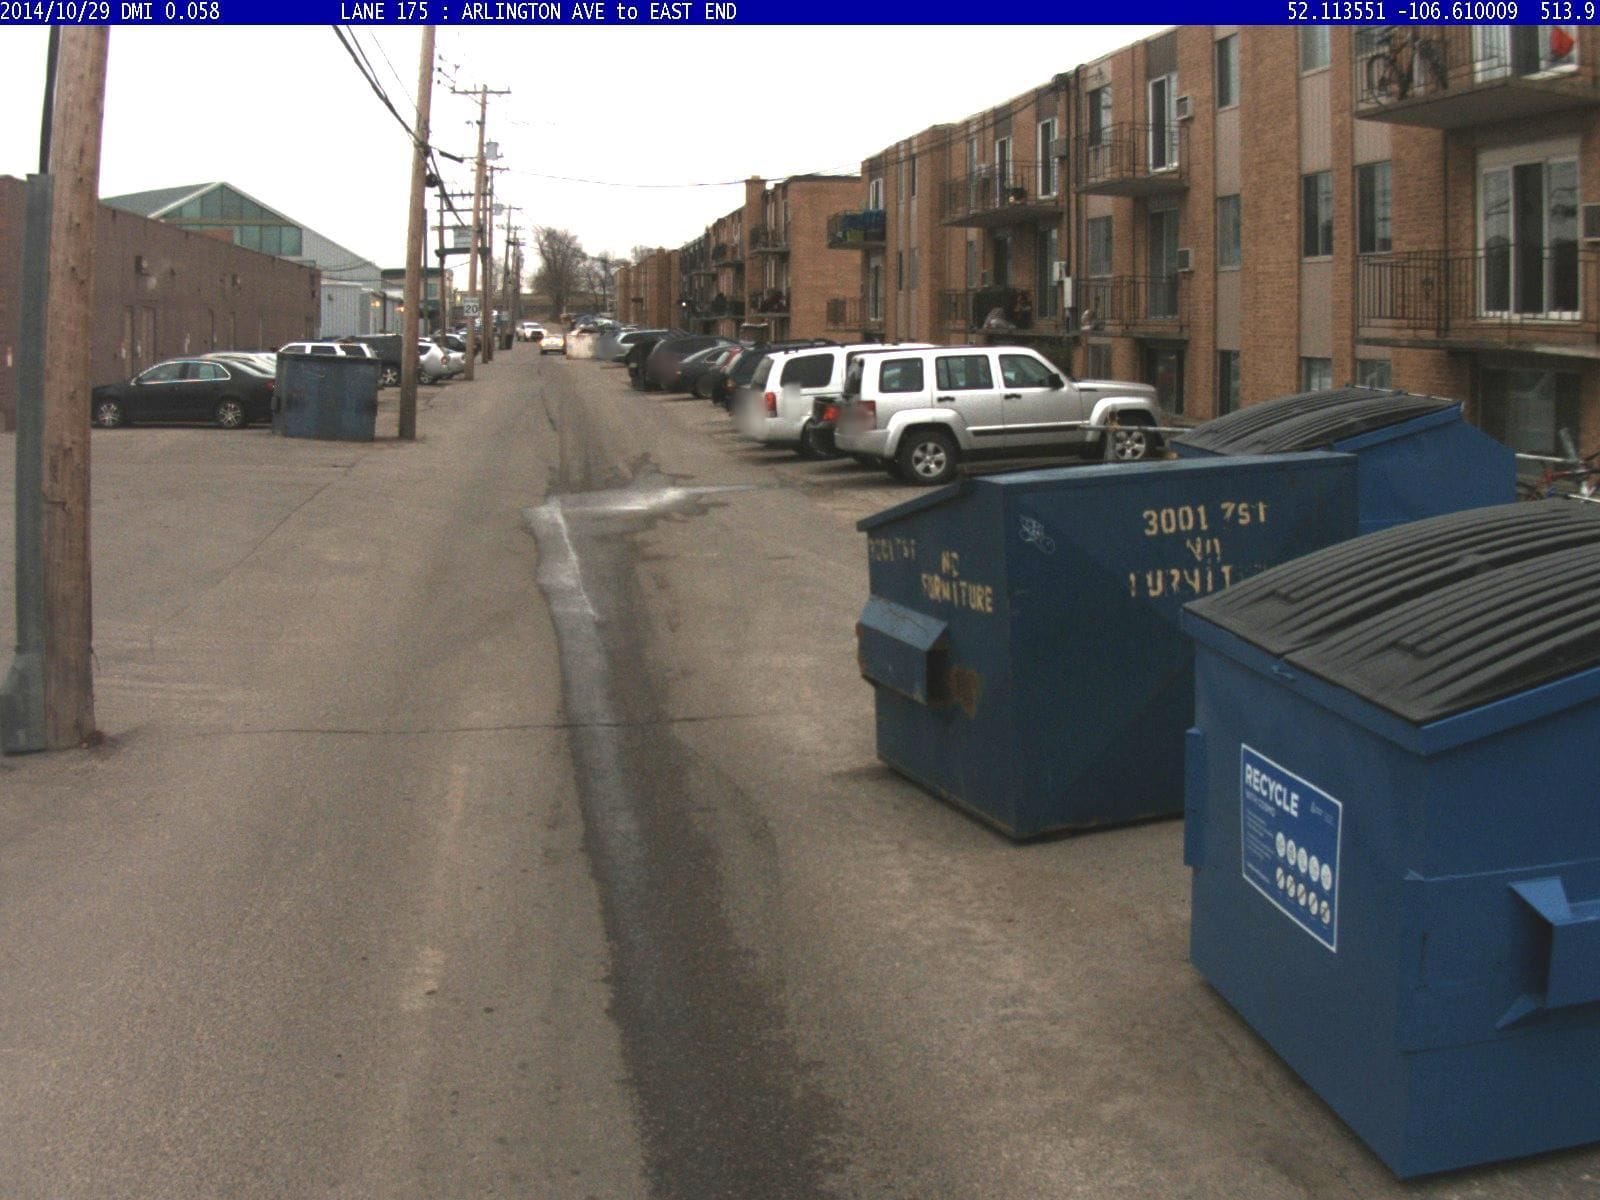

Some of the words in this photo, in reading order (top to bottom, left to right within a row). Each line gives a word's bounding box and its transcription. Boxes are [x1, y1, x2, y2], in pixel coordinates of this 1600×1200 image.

[465, 304, 478, 313] 20
[1142, 505, 1208, 536] 3001
[921, 573, 993, 613] FURNITURE
[1244, 762, 1300, 818] RECYCLE
